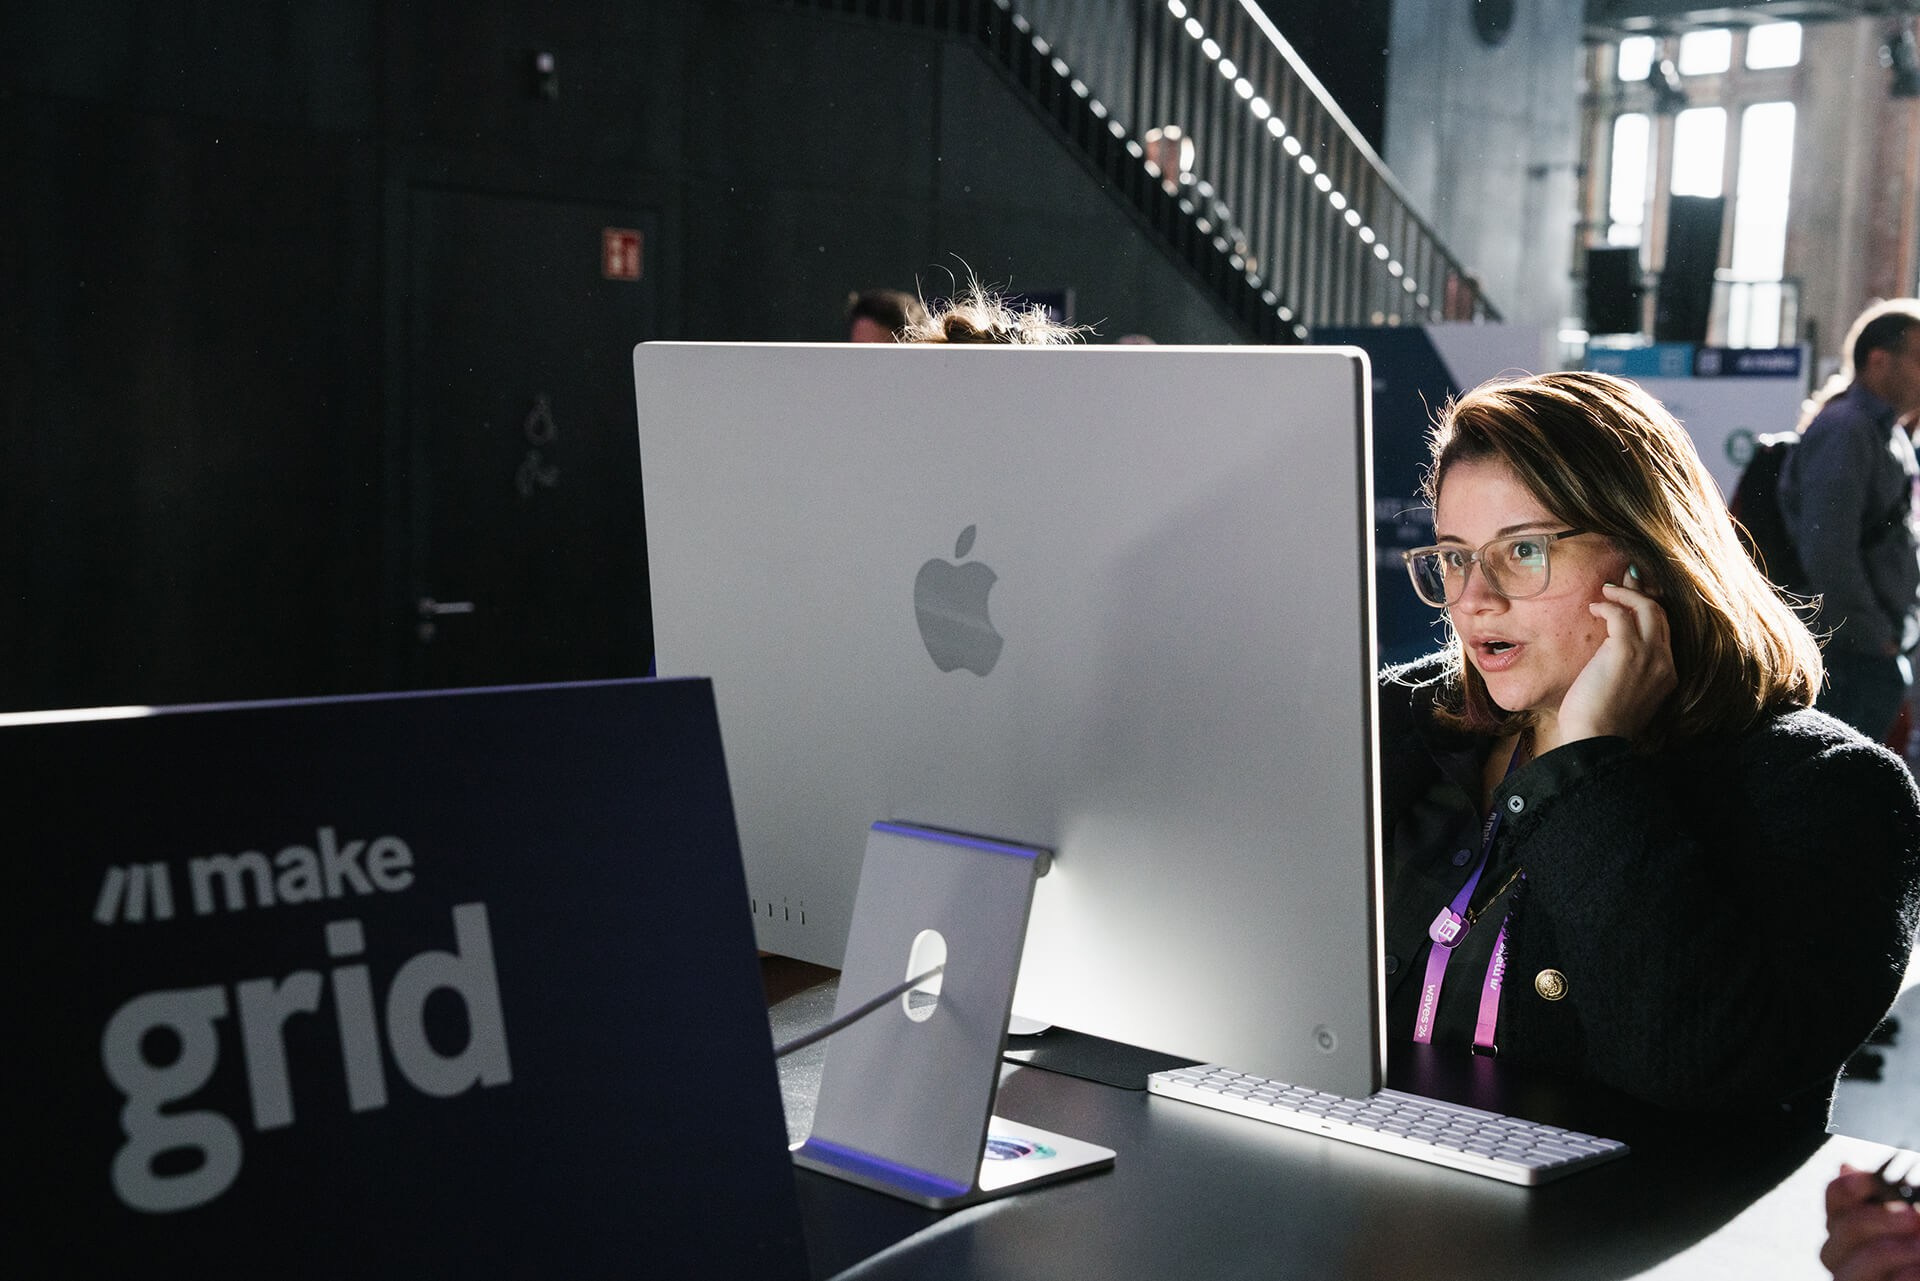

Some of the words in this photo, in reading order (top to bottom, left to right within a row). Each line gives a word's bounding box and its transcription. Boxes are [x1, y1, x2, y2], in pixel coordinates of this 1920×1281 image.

[187, 825, 416, 916] make
[1421, 984, 1436, 1024] waves
[102, 901, 513, 1214] grid
